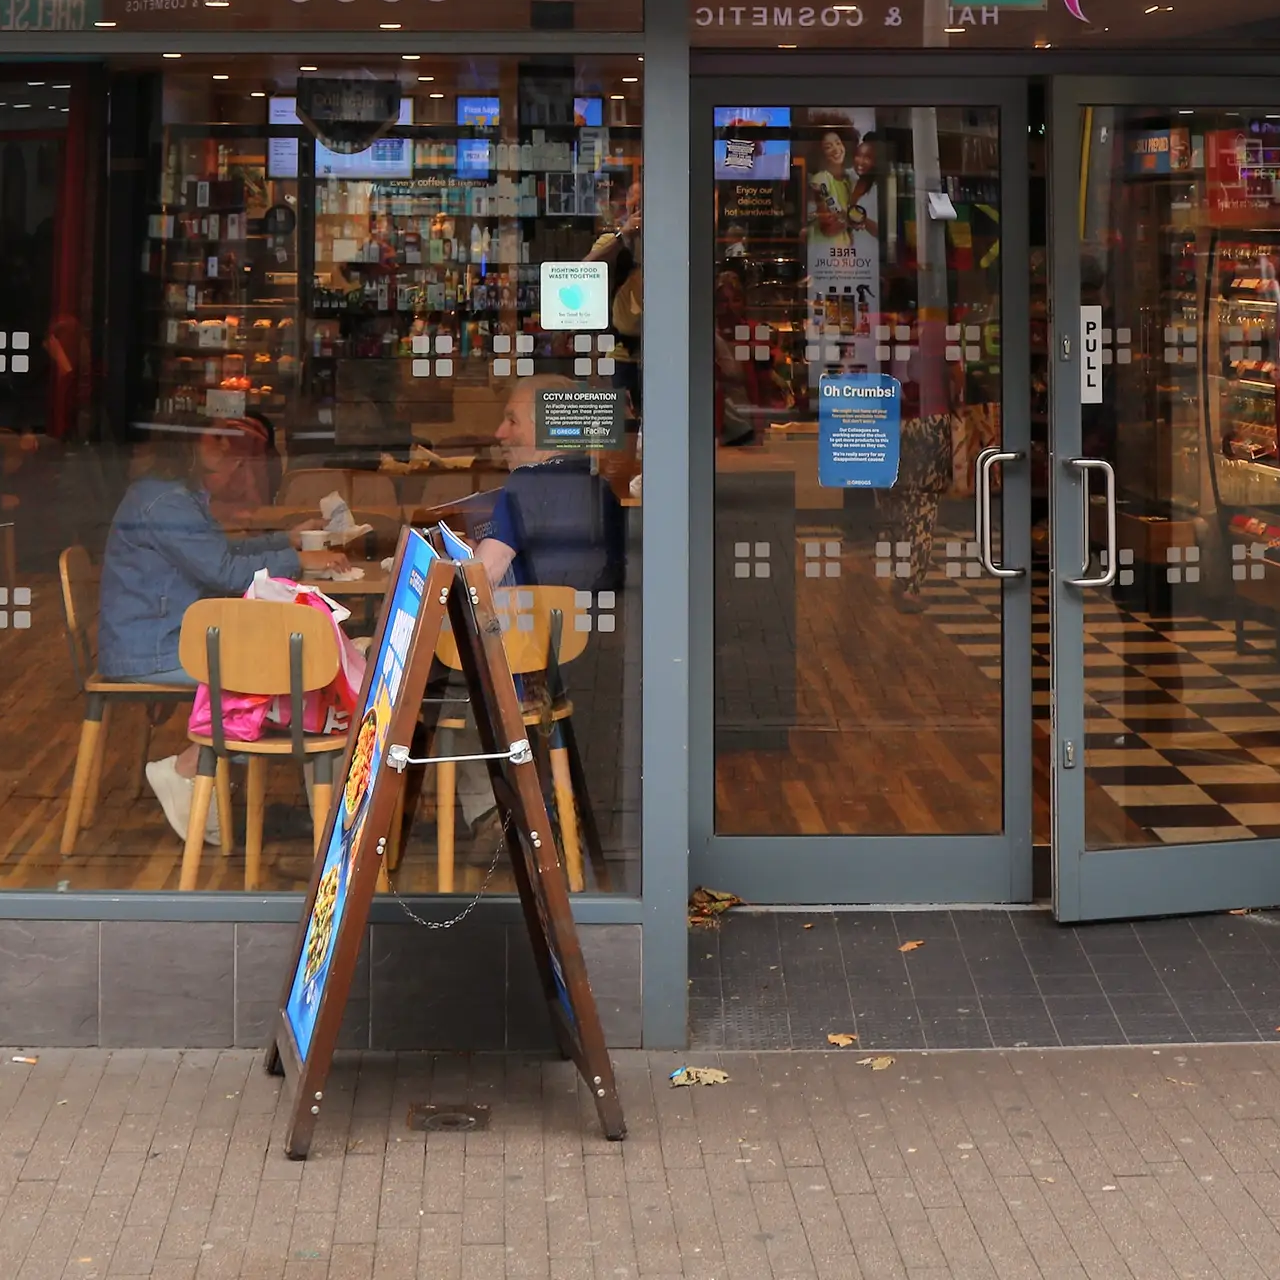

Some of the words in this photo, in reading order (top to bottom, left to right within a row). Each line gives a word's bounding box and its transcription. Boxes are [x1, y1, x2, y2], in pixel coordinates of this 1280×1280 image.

[418, 177, 446, 187] coffee
[448, 177, 455, 187] is
[737, 197, 772, 206] delicious
[1085, 321, 1097, 388] PULL
[823, 385, 840, 397] Oh
[843, 385, 895, 397] Crumbs!
[543, 393, 564, 401] CCTV
[564, 393, 573, 401] IN
[574, 393, 617, 401] OPERATION
